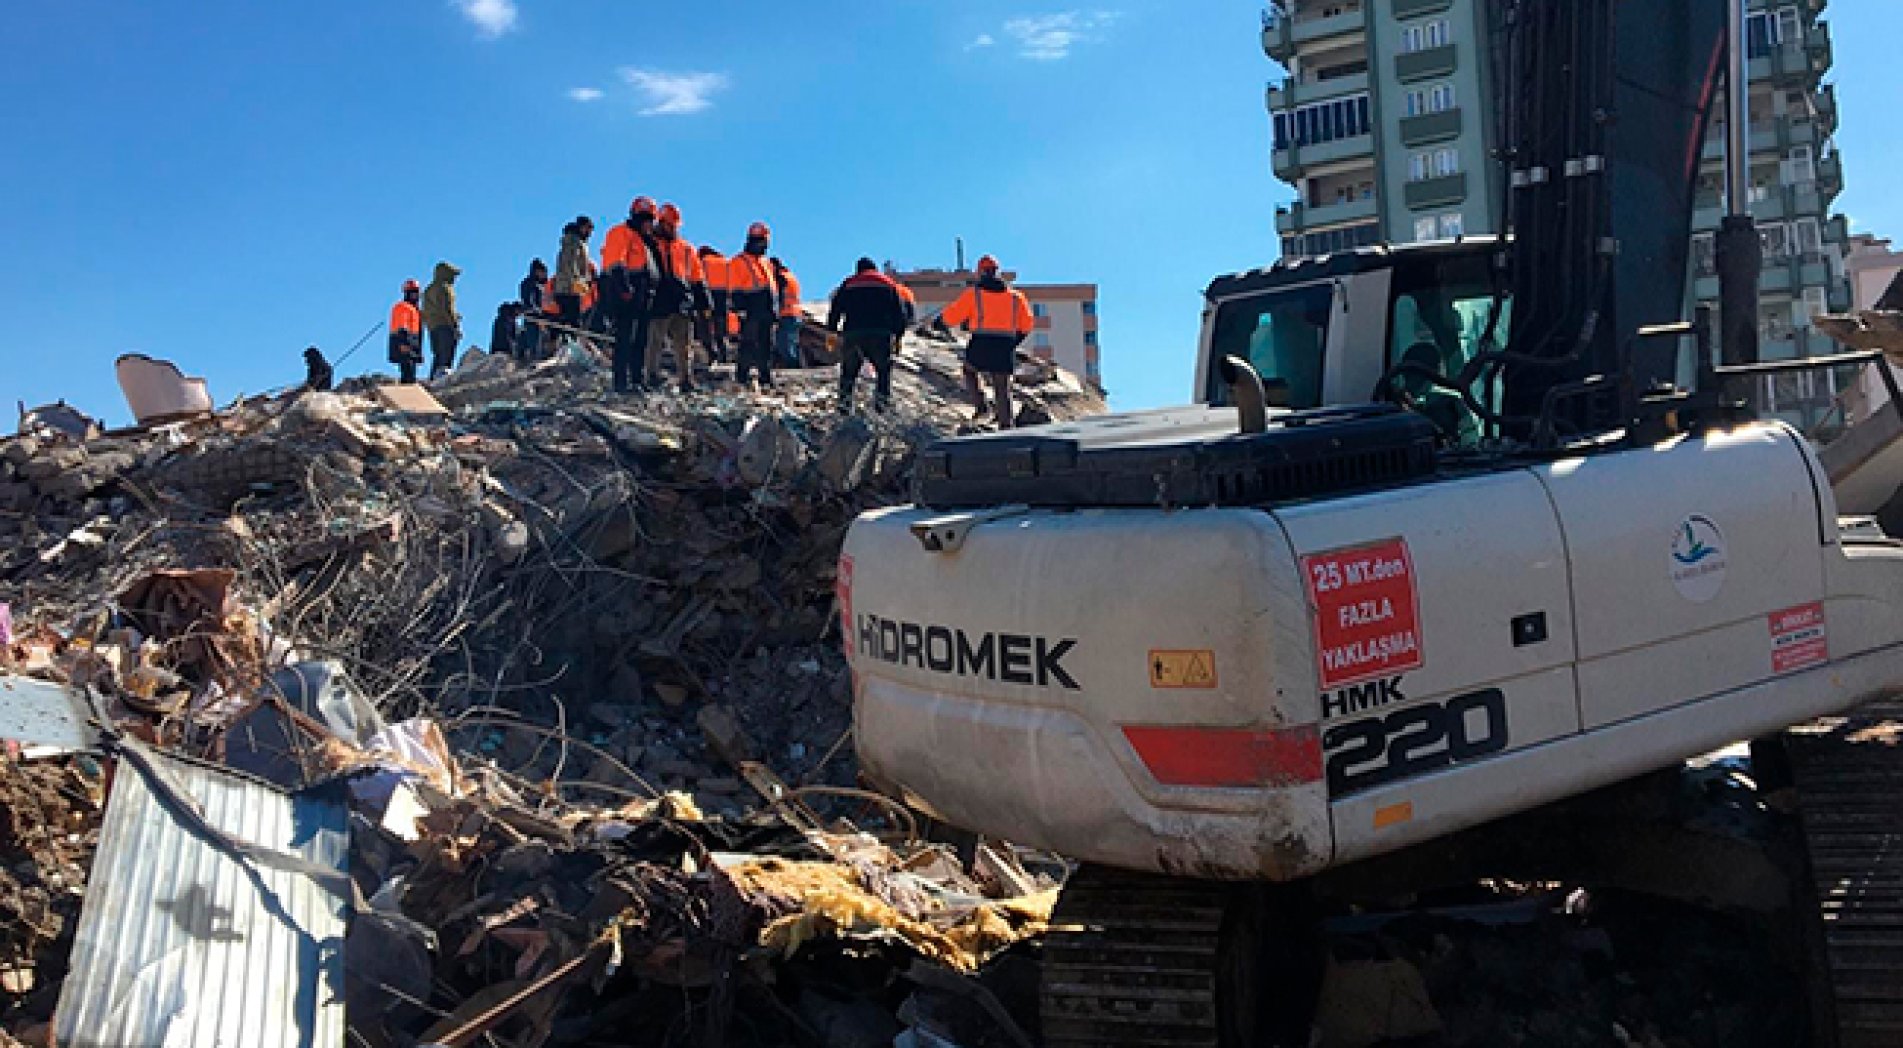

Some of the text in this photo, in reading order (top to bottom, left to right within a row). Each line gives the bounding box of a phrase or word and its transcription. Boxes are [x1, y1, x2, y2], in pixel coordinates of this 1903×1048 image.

[1314, 558, 1405, 592] 25 MT.den
[1338, 598, 1395, 628] FAZLA
[1323, 631, 1416, 671] YAKLAŞMA
[1321, 676, 1405, 718] HMK
[1323, 687, 1508, 803] 220
